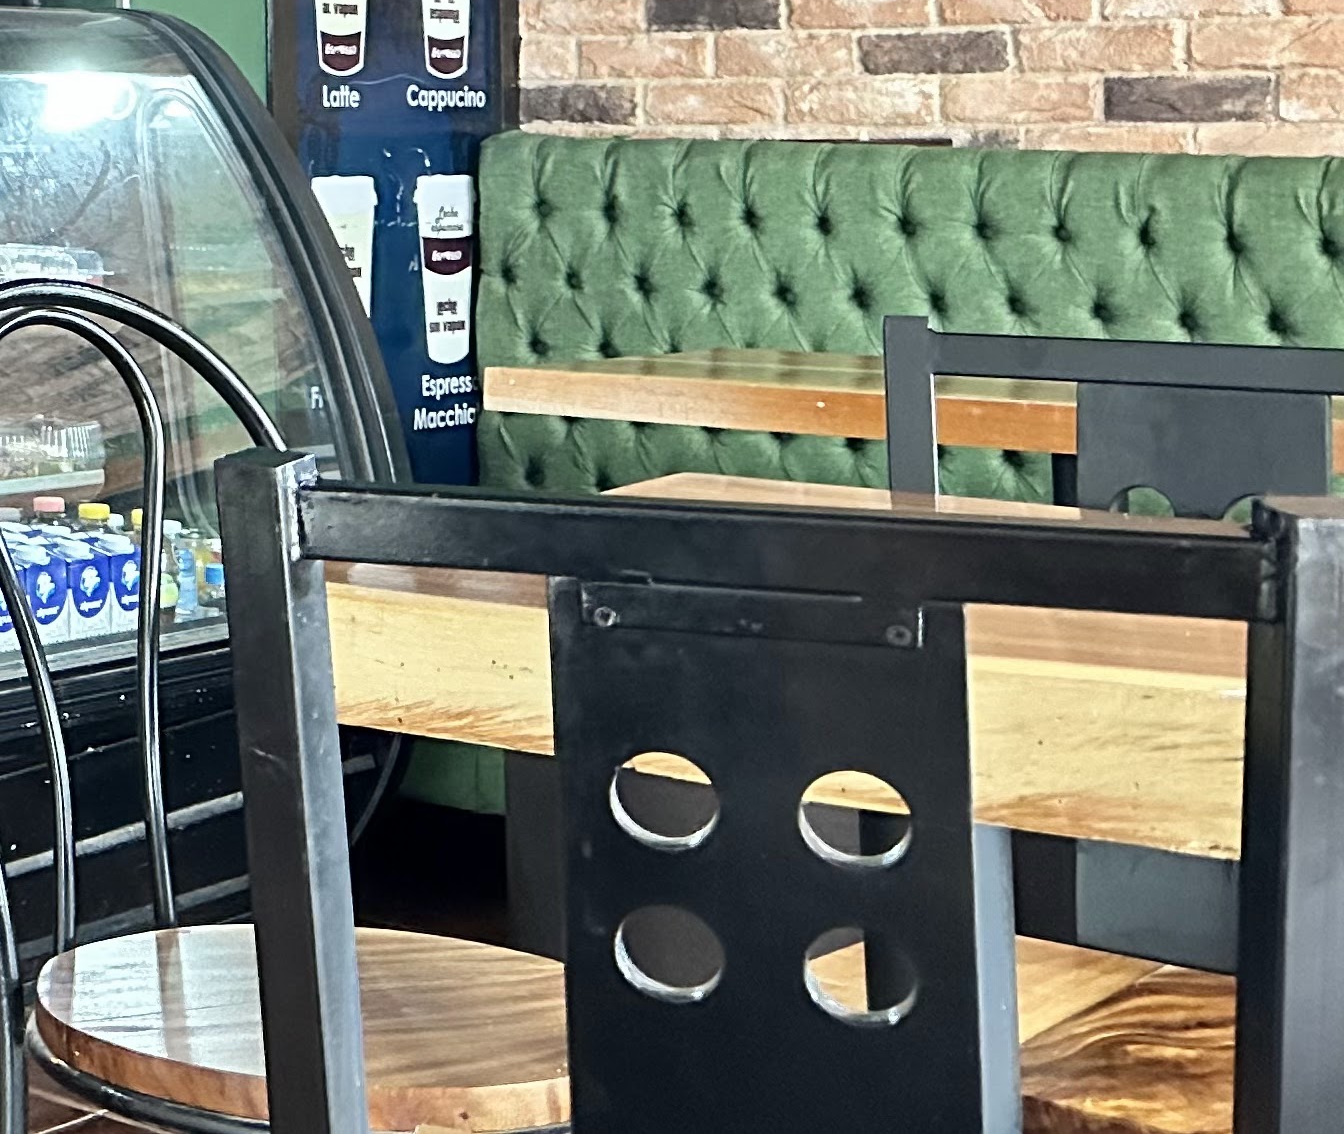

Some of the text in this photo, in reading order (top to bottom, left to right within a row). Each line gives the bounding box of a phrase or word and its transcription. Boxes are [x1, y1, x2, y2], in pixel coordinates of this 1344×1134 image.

[322, 84, 361, 109] Latte
[406, 84, 487, 112] Cappucino
[413, 402, 477, 431] Macchia
